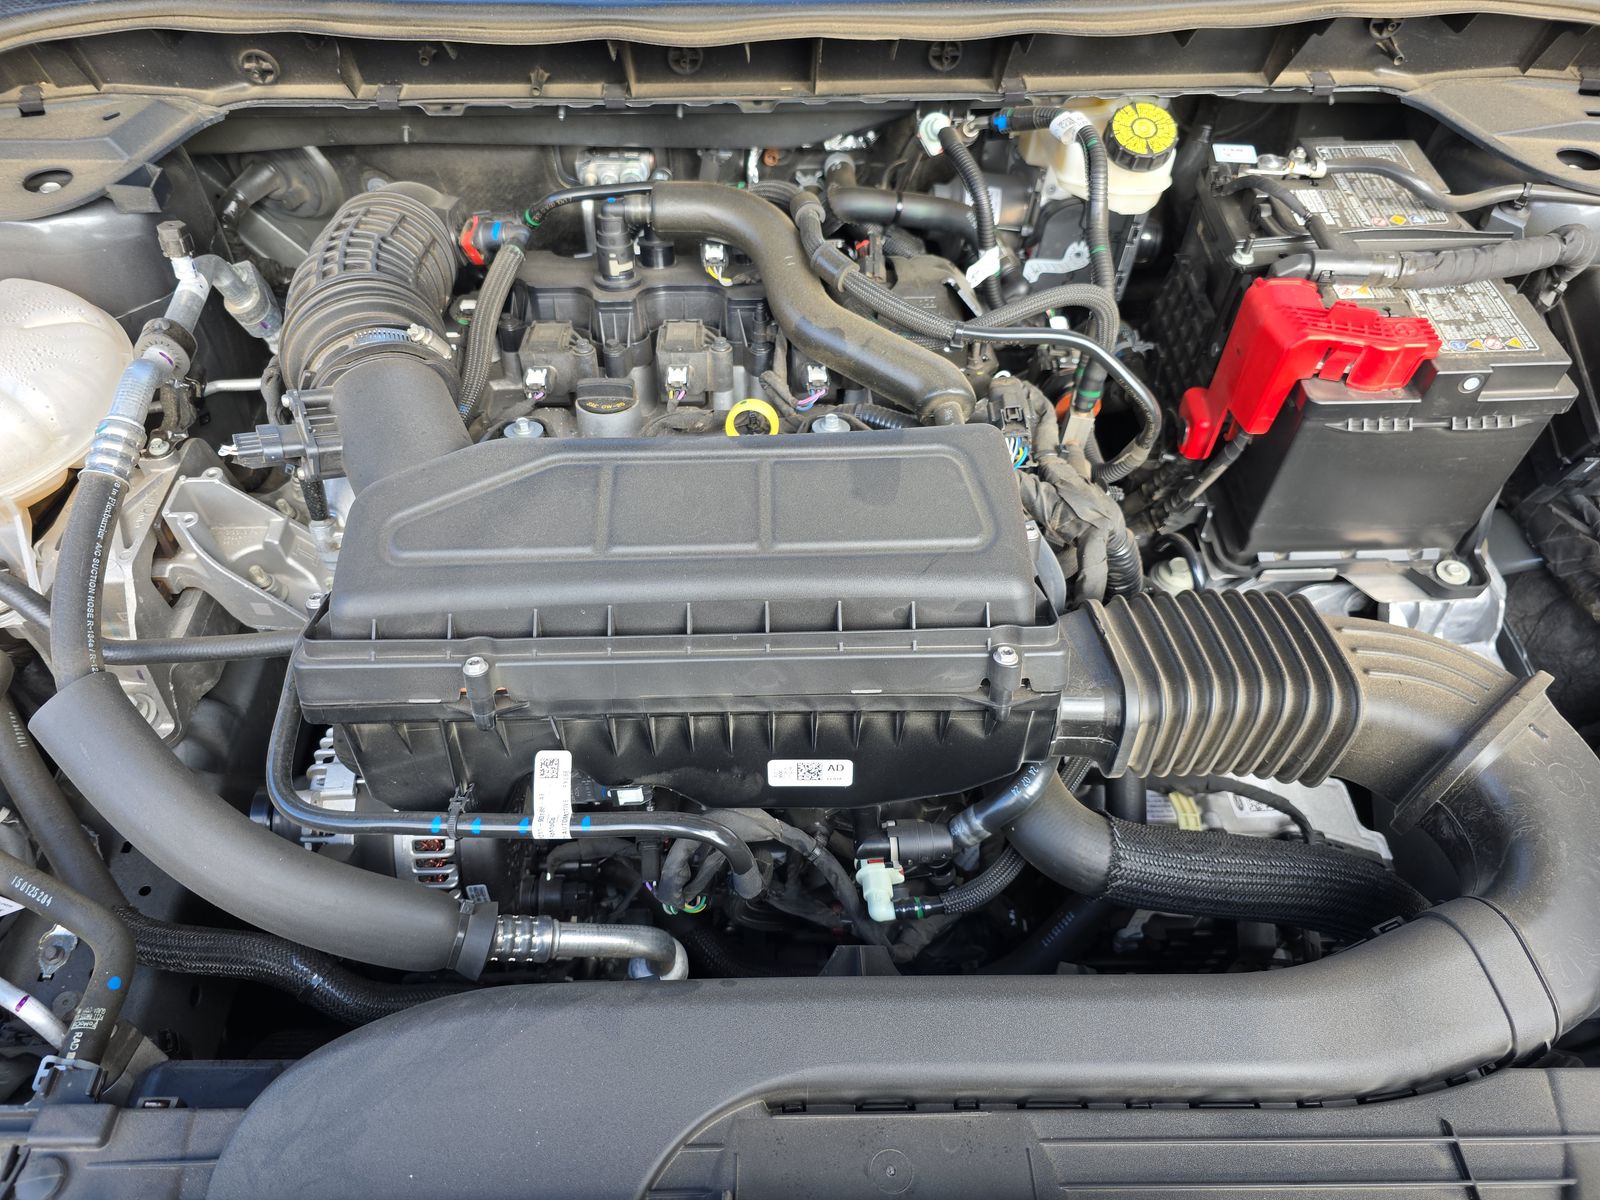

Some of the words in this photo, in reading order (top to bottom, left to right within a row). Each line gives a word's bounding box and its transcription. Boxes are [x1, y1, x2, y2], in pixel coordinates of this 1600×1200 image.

[88, 558, 100, 595] SUCTION
[87, 595, 95, 619] HOSE
[89, 653, 99, 674] R-12
[827, 764, 845, 772] AD
[70, 1031, 84, 1051] RAD
